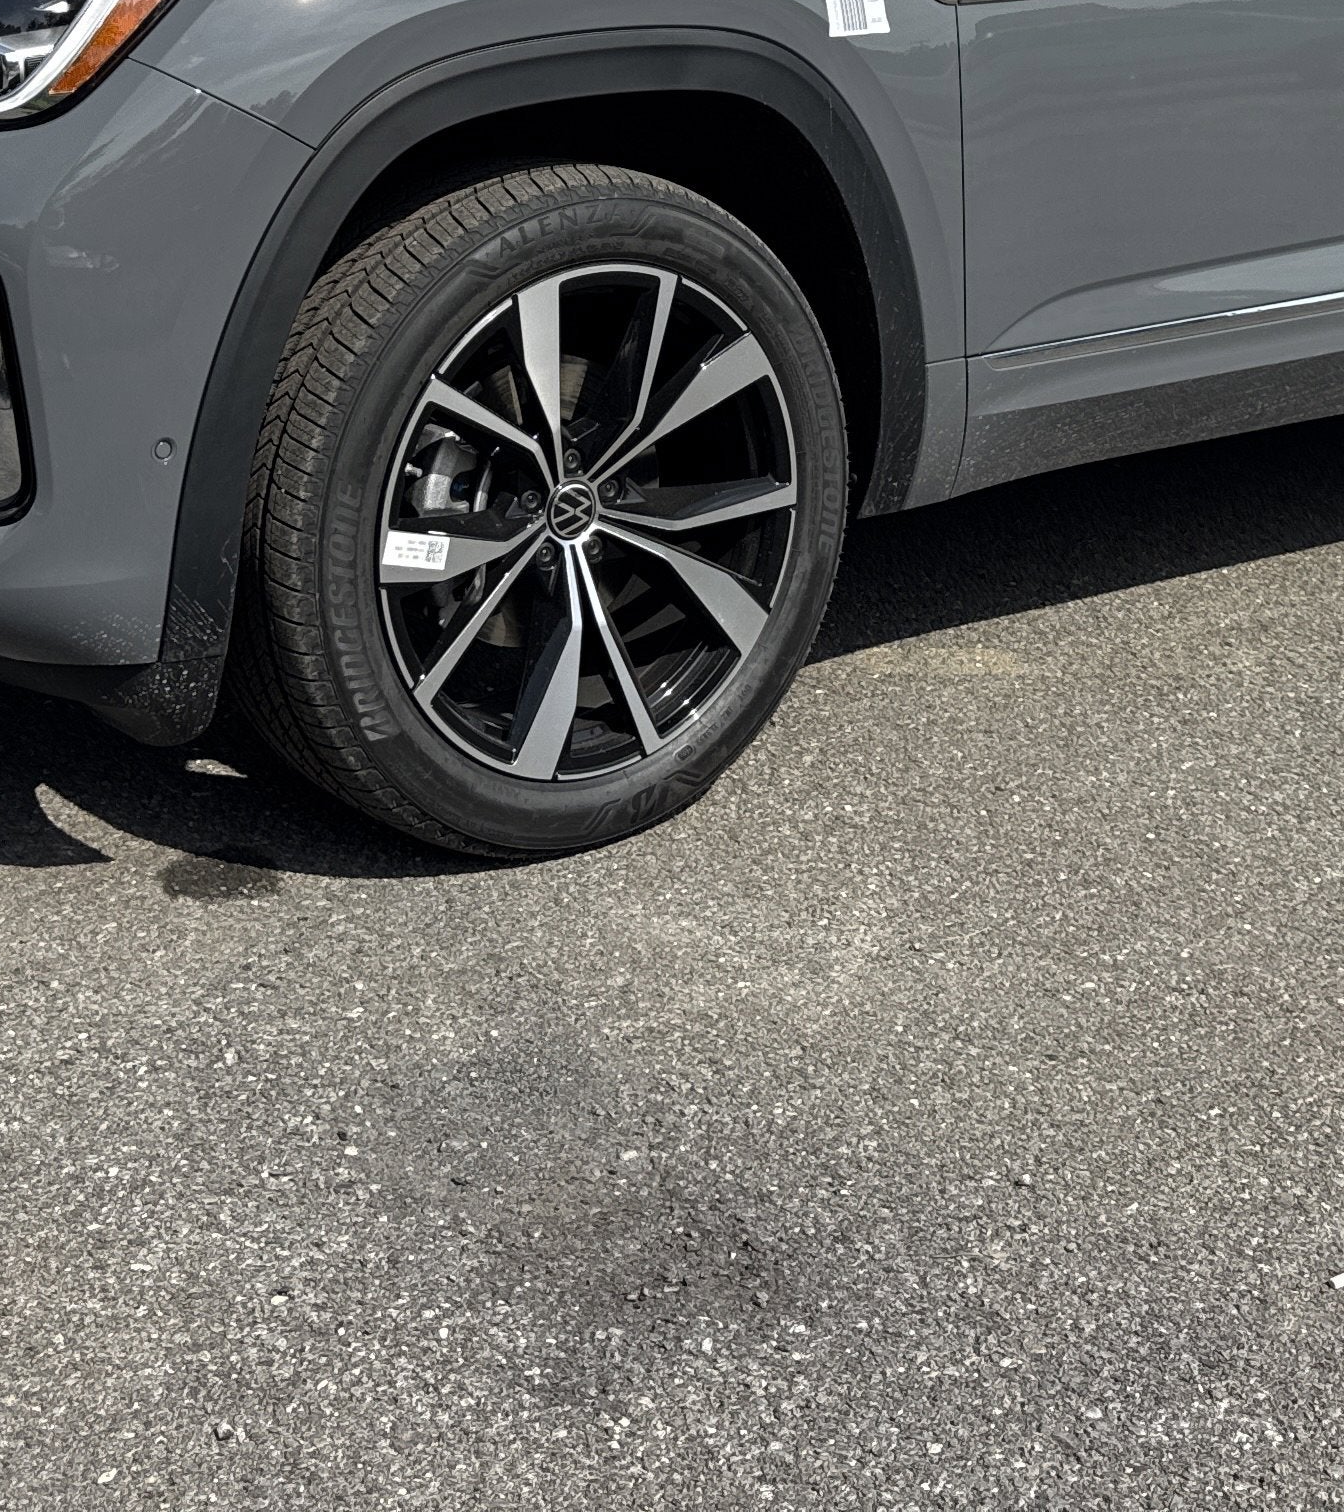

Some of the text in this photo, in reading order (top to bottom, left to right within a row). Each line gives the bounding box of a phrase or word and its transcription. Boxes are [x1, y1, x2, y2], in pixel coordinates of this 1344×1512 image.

[498, 202, 633, 257] ALENZA
[785, 320, 843, 567] BRIDGESTONE
[321, 479, 402, 742] BRIDGESTONE
